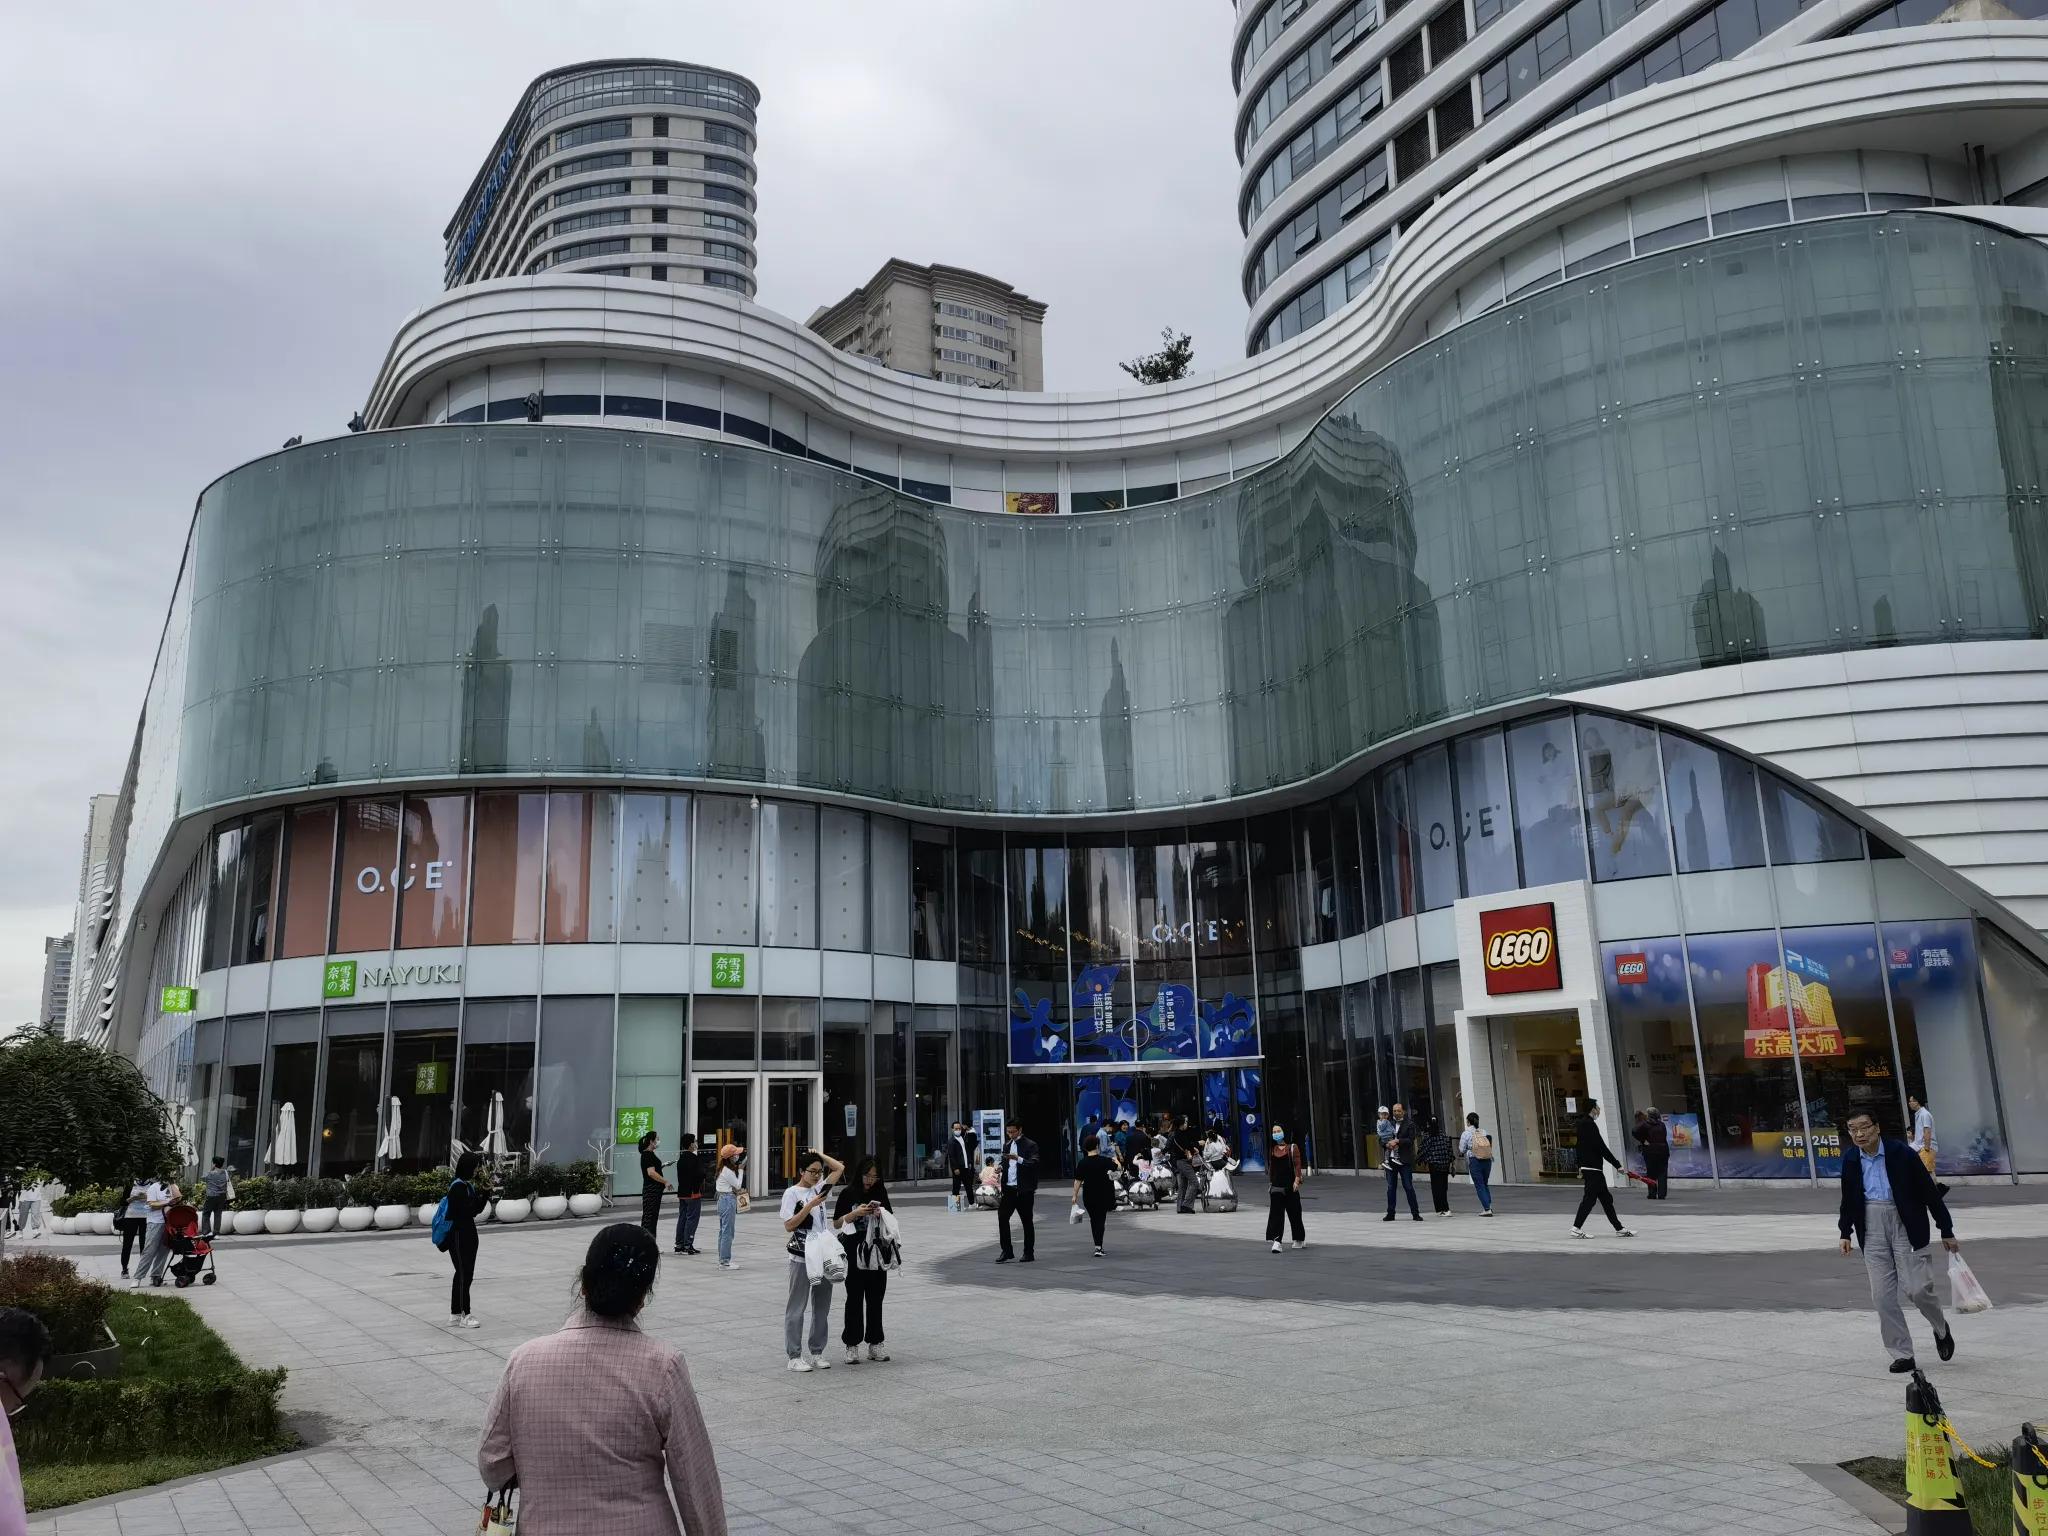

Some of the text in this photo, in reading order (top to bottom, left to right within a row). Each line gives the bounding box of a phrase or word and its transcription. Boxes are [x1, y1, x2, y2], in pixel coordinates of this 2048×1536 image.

[1488, 929, 1551, 968] LEGO
[362, 965, 462, 988] NAYUKI
[1618, 962, 1645, 975] LEGO
[1104, 993, 1113, 1011] LESS
[1754, 1033, 1838, 1055] 乐高大师
[1784, 1135, 1840, 1147] 9月 24日
[1920, 1433, 1936, 1480] 步行广场
